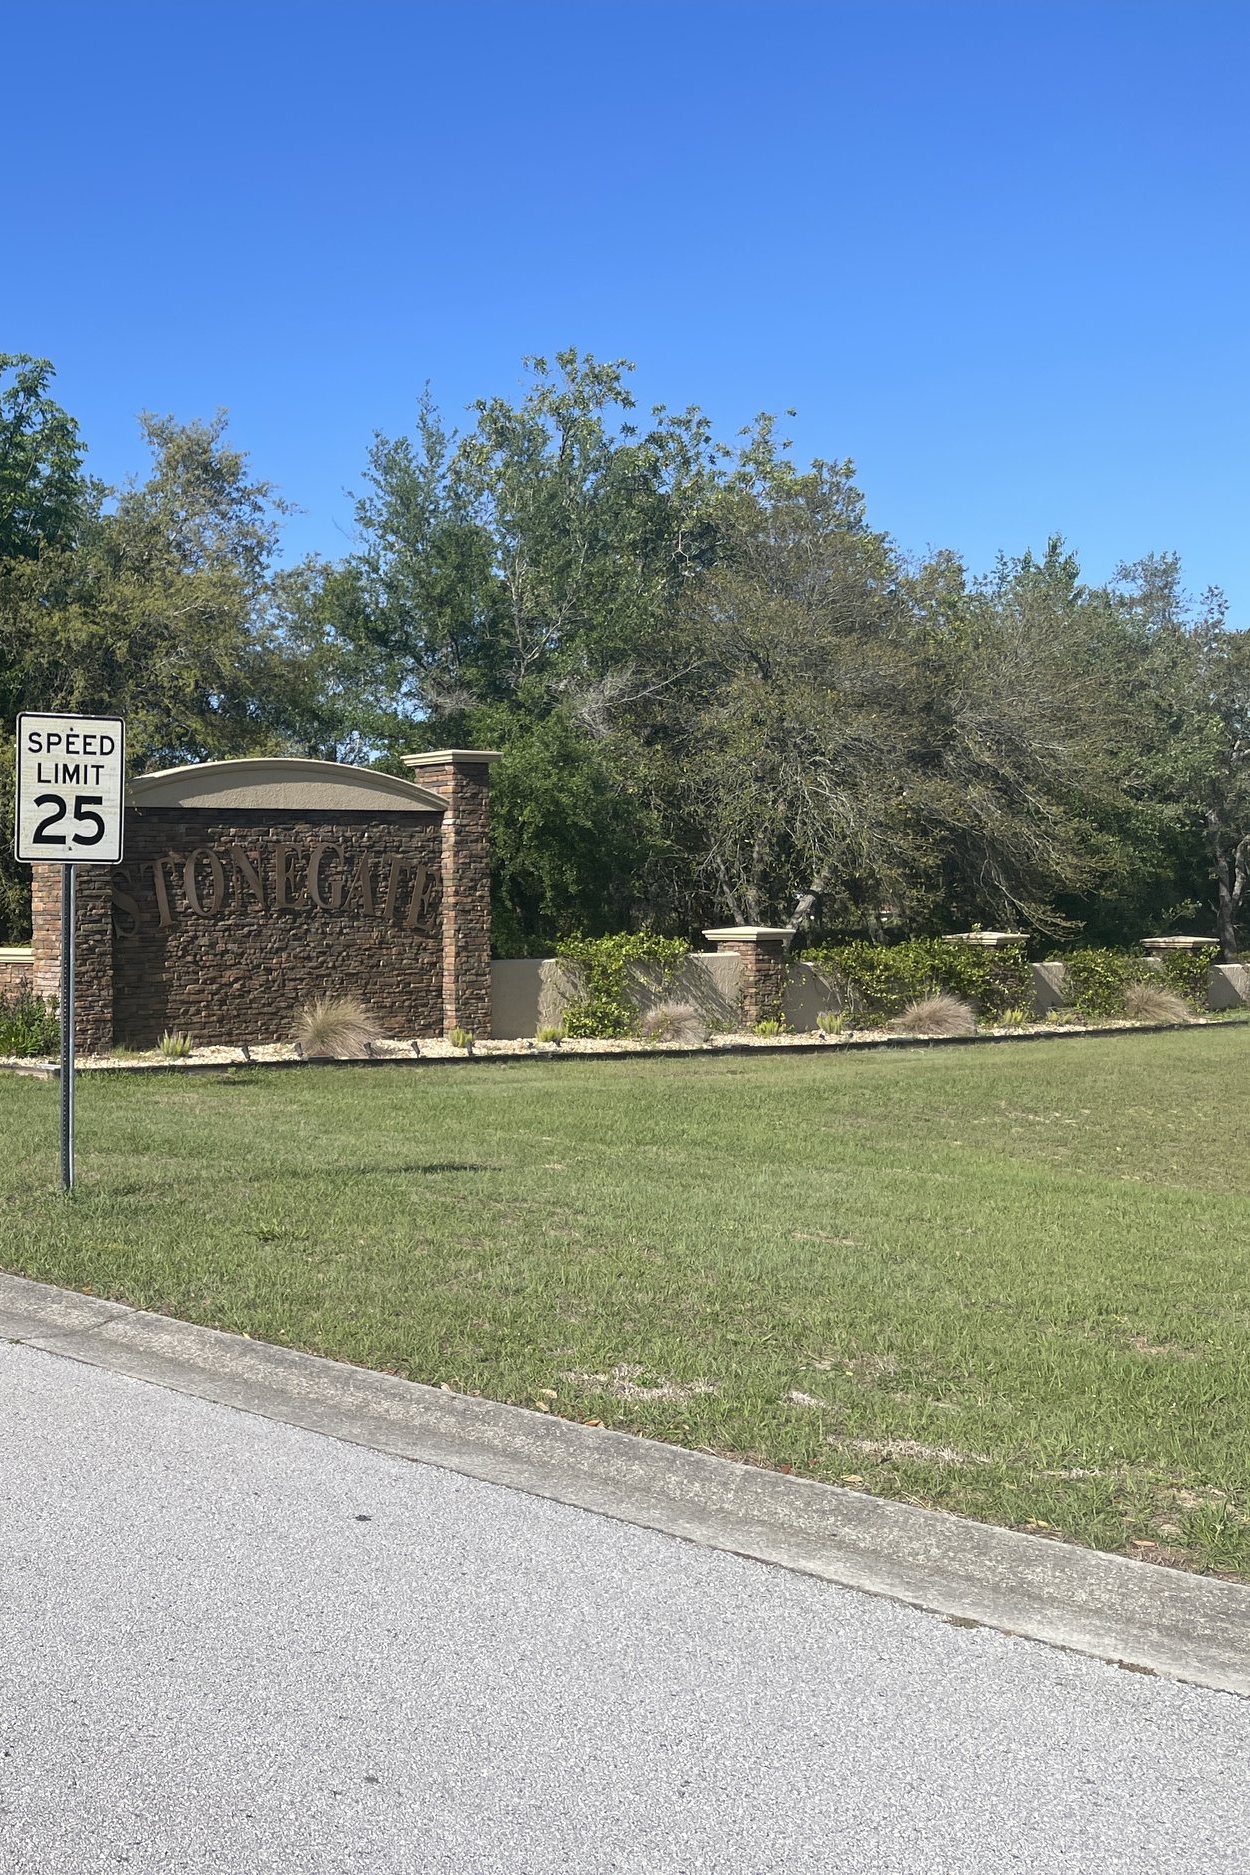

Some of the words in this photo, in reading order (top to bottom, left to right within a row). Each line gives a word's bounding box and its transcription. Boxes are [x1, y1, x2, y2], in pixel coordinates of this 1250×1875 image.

[28, 732, 115, 756] SPEED
[37, 763, 105, 785] LIMIT
[32, 794, 106, 845] 25
[111, 842, 442, 940] STONEGATE
